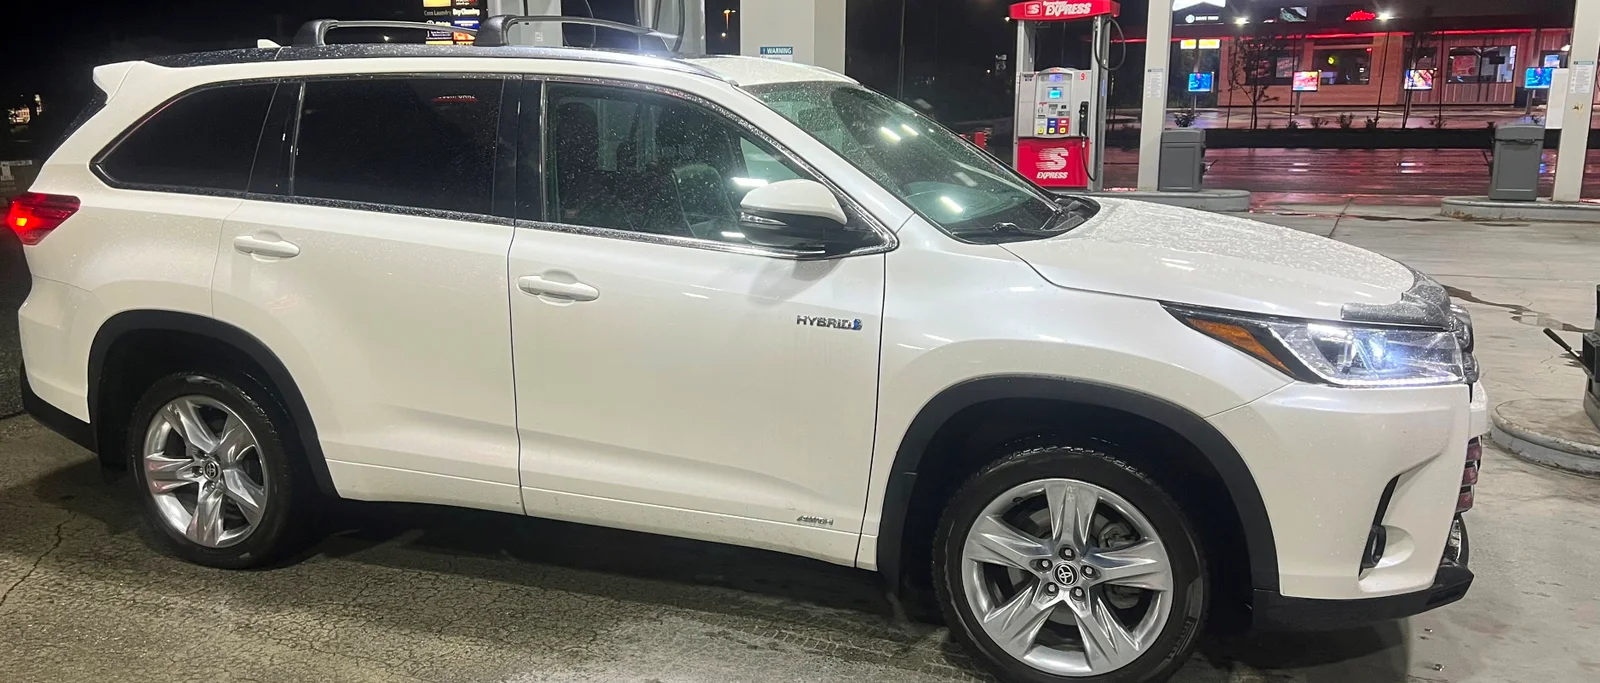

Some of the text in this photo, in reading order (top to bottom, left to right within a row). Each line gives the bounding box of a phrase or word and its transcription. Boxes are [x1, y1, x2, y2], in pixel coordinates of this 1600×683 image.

[1045, 3, 1092, 16] EXPRESS
[1036, 147, 1069, 171] S
[1036, 171, 1068, 179] EXPRESS
[796, 315, 852, 330] HYBRID
